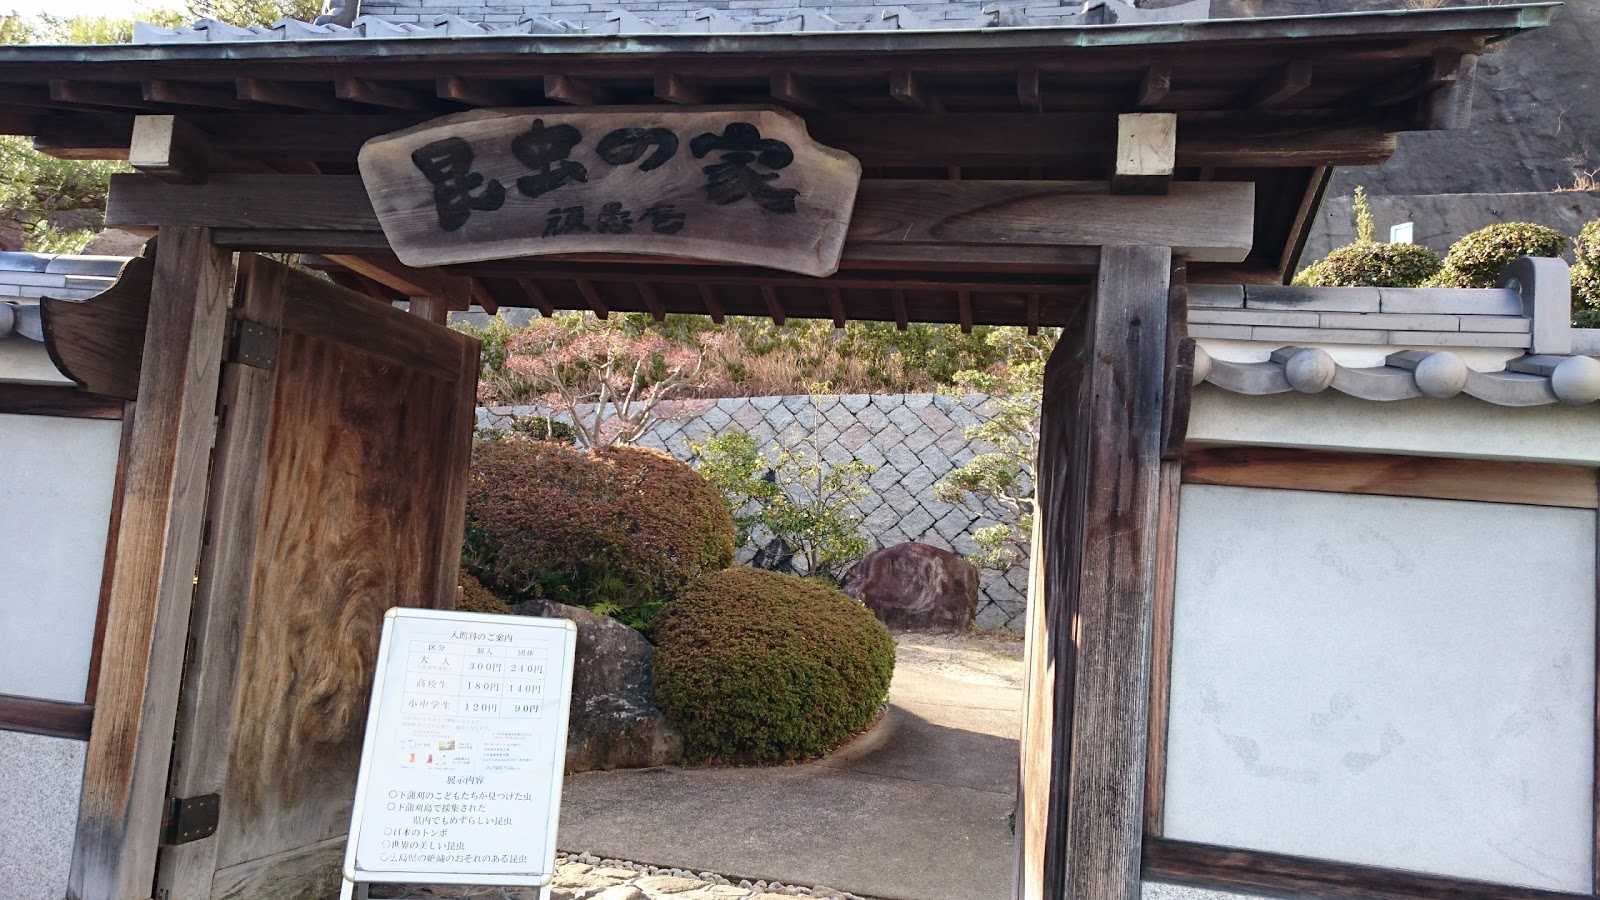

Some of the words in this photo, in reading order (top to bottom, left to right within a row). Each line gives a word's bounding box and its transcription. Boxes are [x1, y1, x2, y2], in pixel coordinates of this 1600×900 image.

[411, 118, 800, 231] 昆虫の家
[416, 679, 448, 690] 高校生
[408, 700, 450, 711] 小中学生
[446, 775, 485, 786] 展示内容
